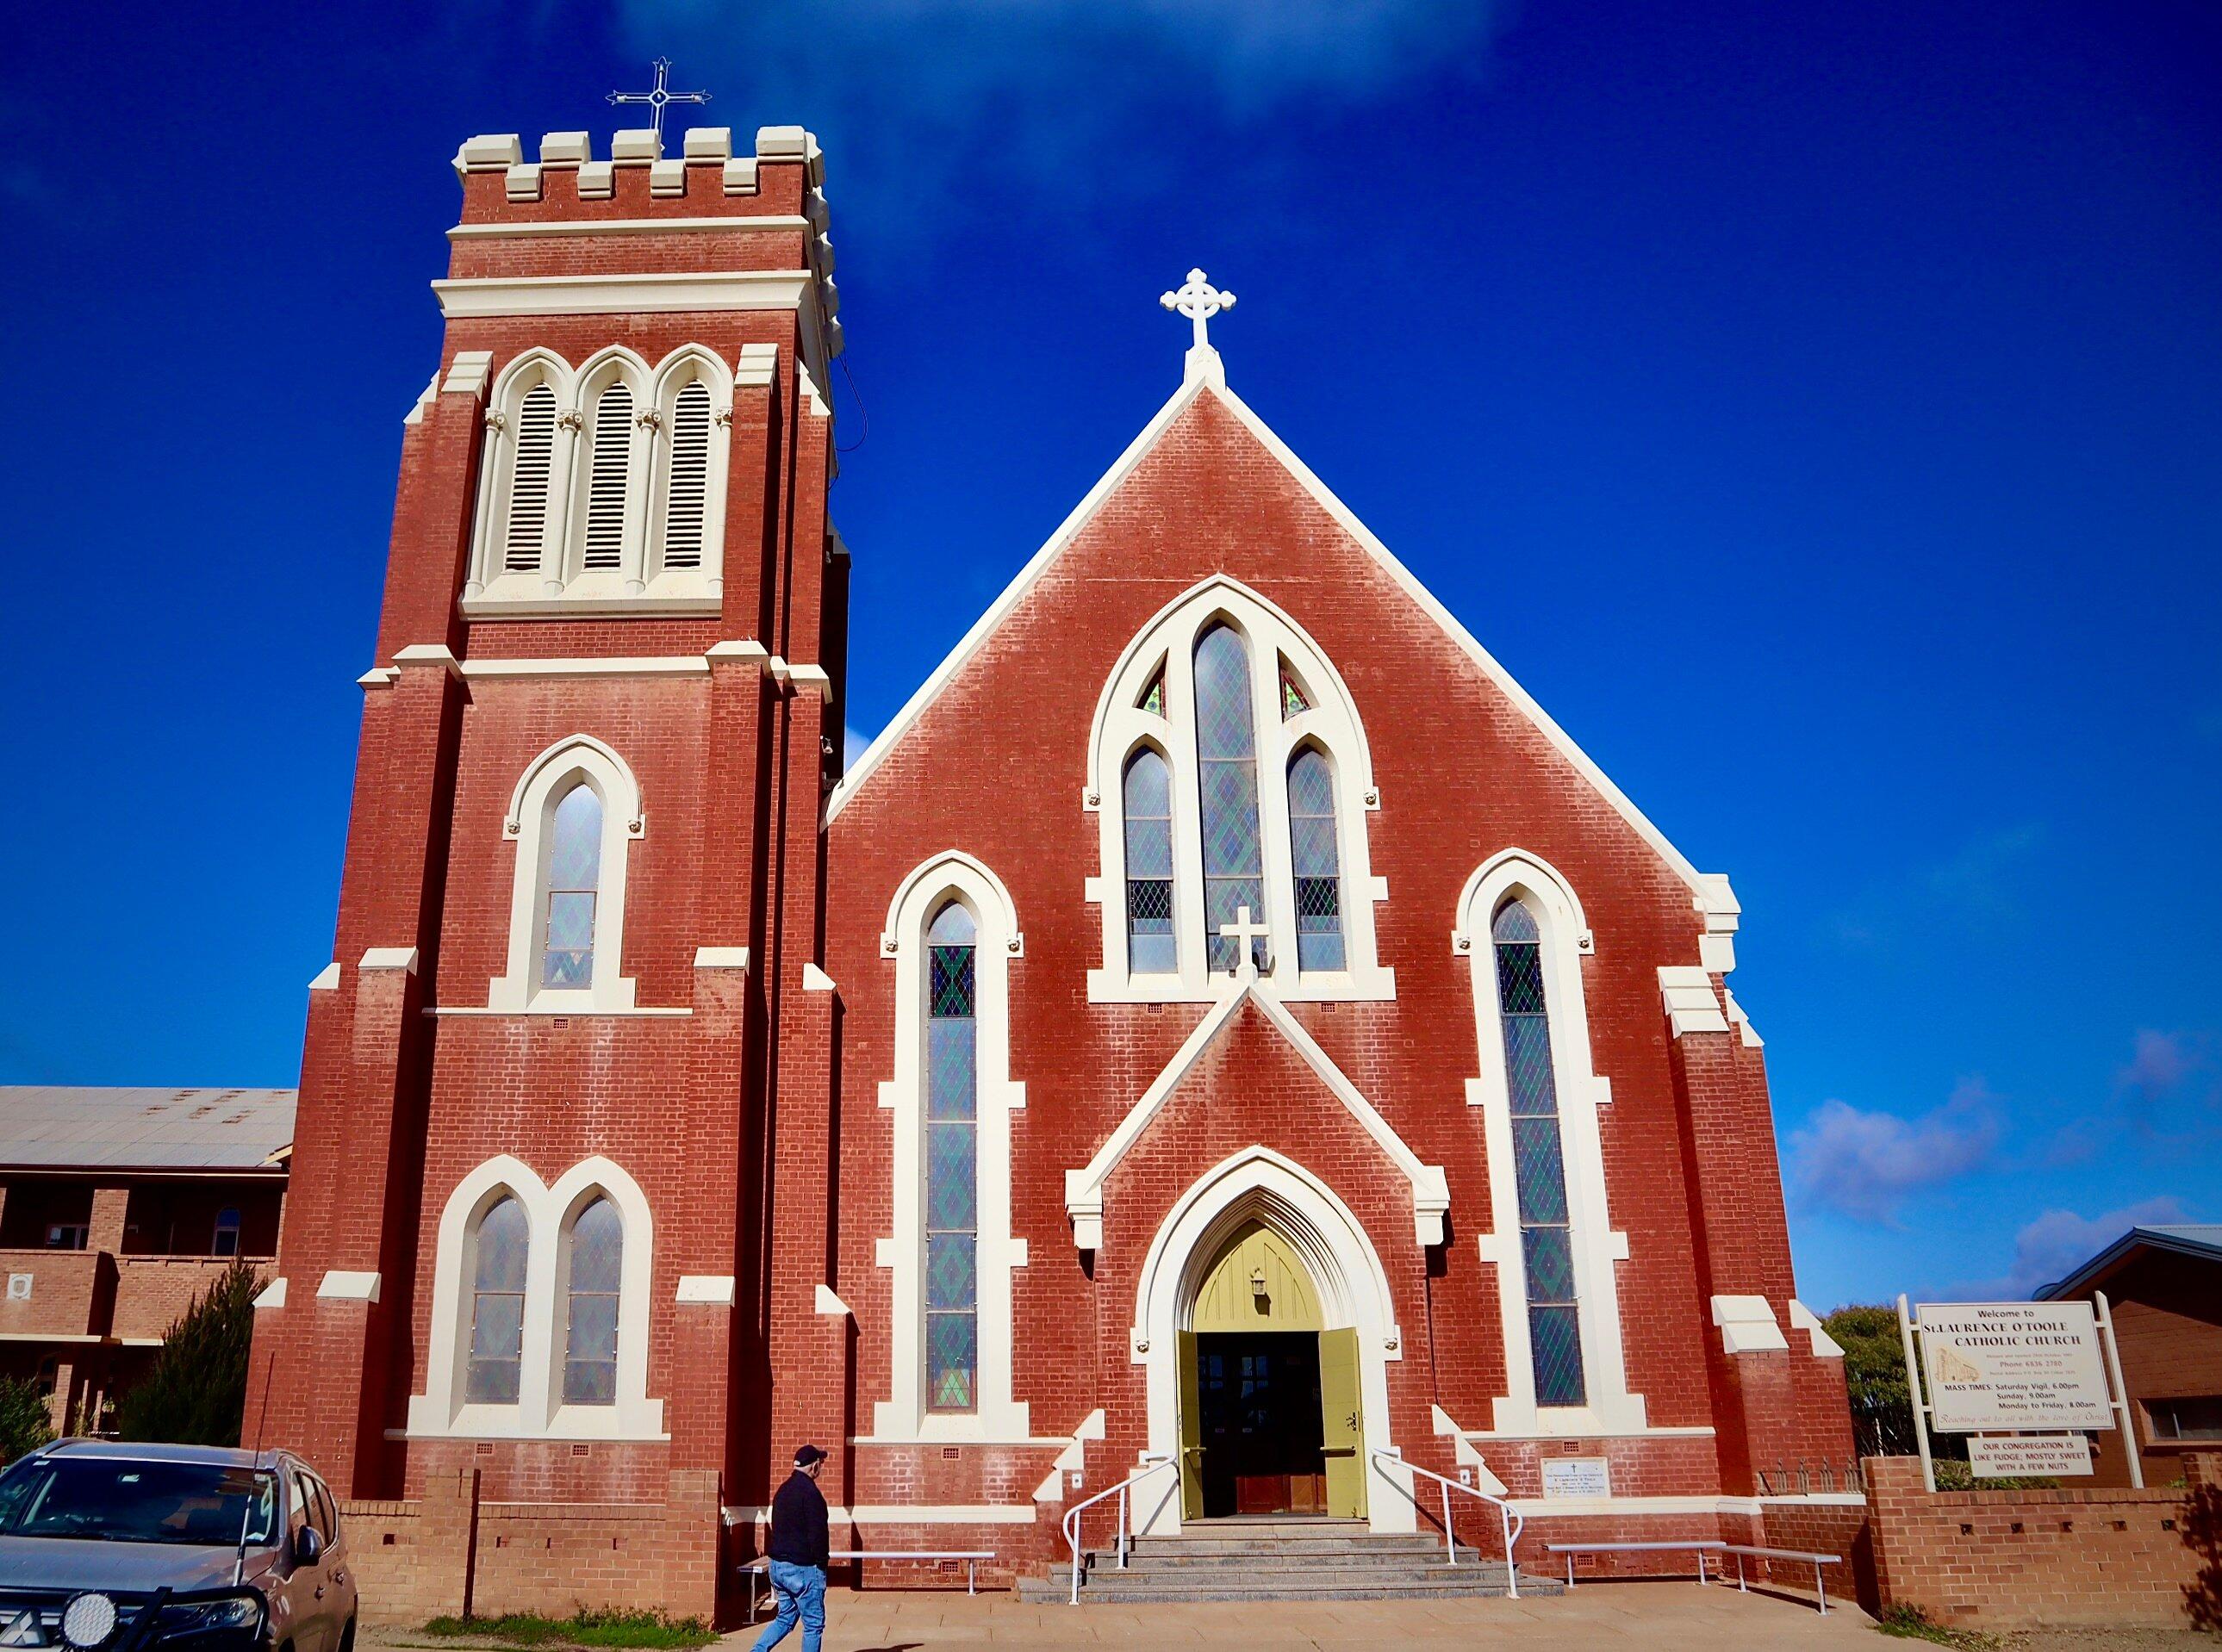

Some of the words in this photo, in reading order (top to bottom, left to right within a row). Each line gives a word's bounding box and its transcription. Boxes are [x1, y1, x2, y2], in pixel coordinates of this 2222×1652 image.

[2013, 1322, 2068, 1332] O'TOOLE
[1955, 1337, 2020, 1346] CATHOLIC
[2026, 1335, 2082, 1345] CHURCH
[1995, 1382, 2028, 1392] Saturday
[2031, 1383, 2050, 1392] Vigil,
[2052, 1382, 2079, 1391] 6.00pm
[1939, 1413, 1976, 1424] Reaching
[2072, 1414, 2080, 1423] of
[2002, 1442, 2063, 1450] CONGREGATION
